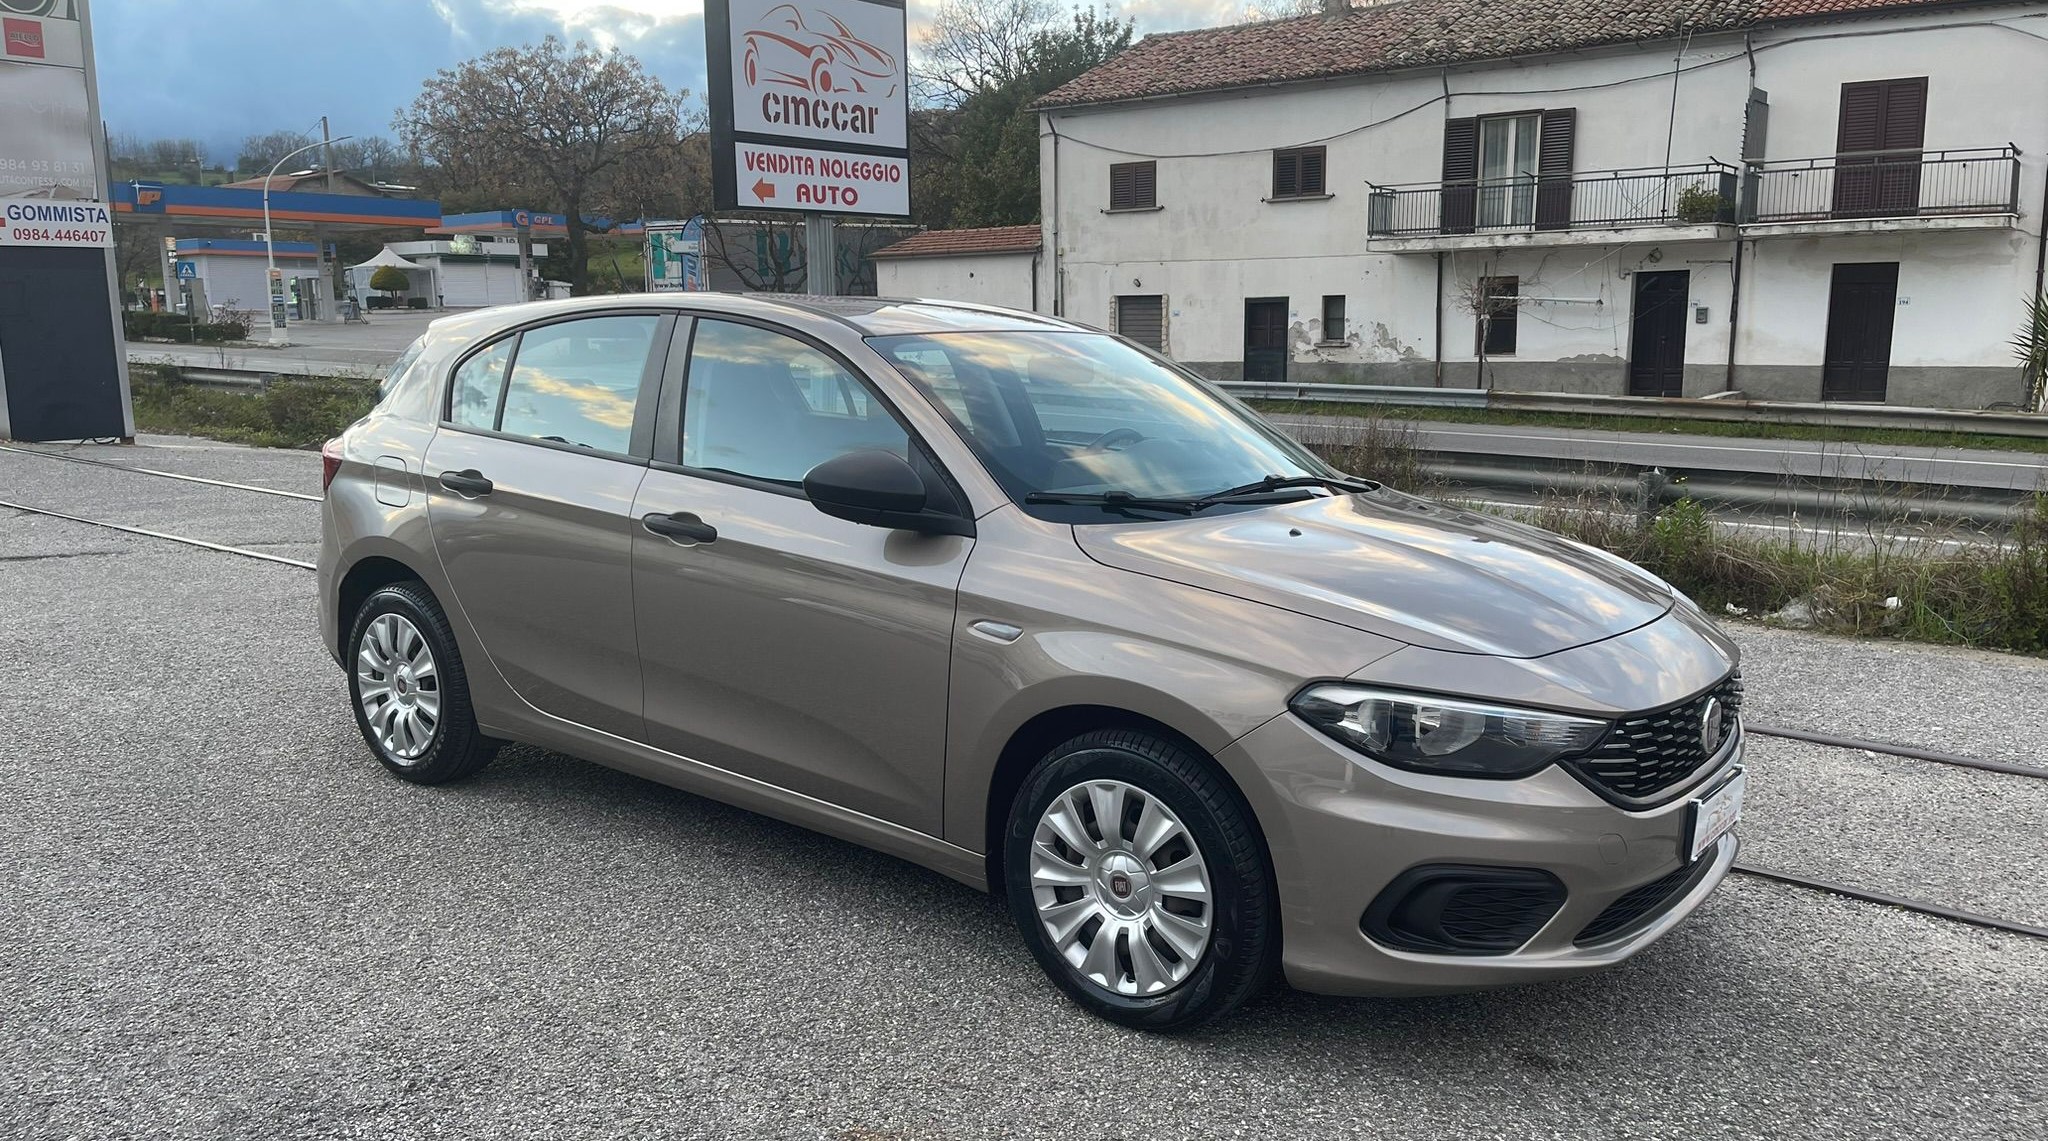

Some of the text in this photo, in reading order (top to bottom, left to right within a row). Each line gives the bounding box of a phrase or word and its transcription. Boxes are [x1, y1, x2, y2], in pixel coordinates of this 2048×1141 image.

[31, 159, 49, 172] 93
[744, 151, 901, 183] VENDITA NOLEGGIO
[796, 183, 859, 206] AUTO
[7, 205, 110, 224] GOMMISTA
[534, 215, 554, 225] GPL
[13, 228, 107, 243] 0984.446407
